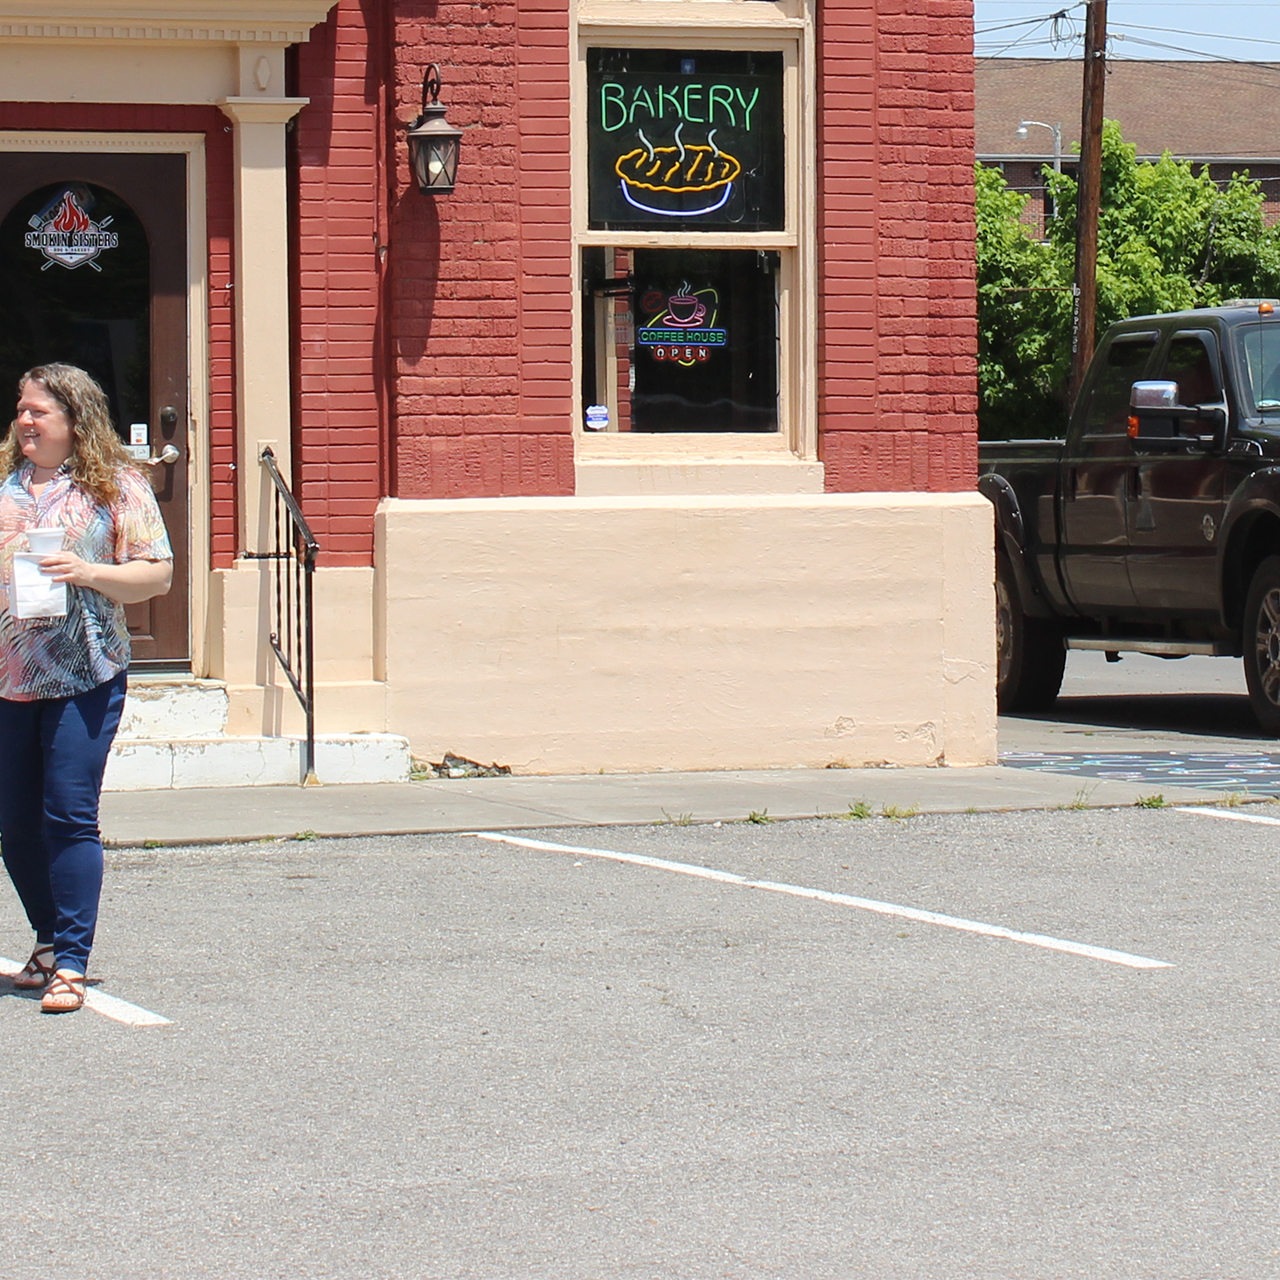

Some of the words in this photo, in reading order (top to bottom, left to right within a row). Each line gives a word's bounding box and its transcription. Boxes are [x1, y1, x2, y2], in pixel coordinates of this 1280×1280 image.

[601, 83, 760, 132] BAKERY
[72, 232, 118, 248] SISTERS
[641, 332, 684, 342] COFFEE
[686, 332, 724, 342] HOUSE
[656, 348, 706, 358] OPEN
